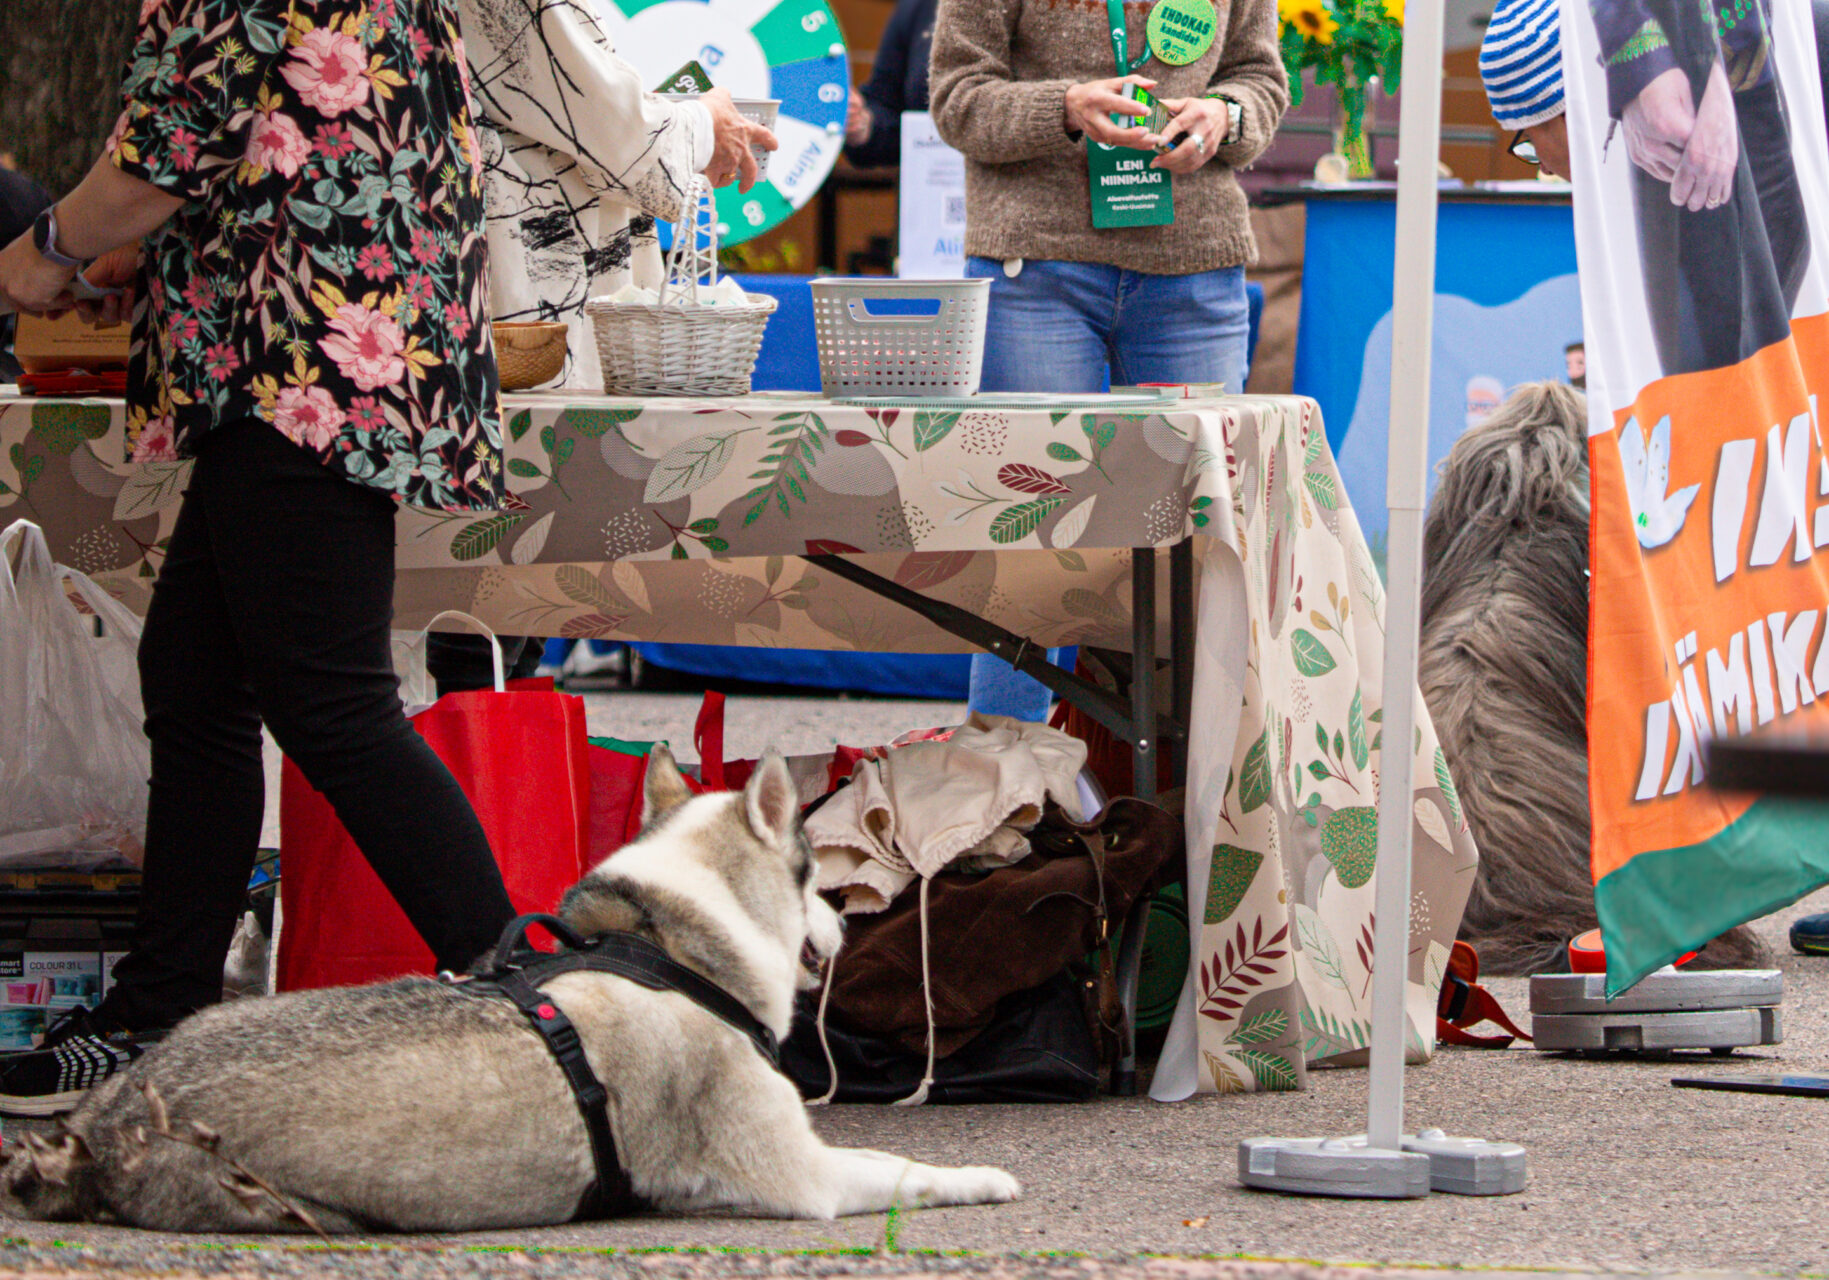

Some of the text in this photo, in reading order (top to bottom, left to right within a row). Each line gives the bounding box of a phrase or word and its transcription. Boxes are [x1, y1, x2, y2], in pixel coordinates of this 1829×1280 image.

[801, 10, 828, 32] 5
[1160, 6, 1211, 36] EHDOKAS
[1160, 22, 1200, 46] kandidat
[817, 83, 845, 103] 6
[784, 140, 822, 187] Alina
[1115, 159, 1145, 171] LENI
[1100, 171, 1162, 187] NIINIMÄKI
[742, 200, 766, 226] 8
[0, 960, 20, 968] mart
[29, 961, 65, 970] COLOUR
[66, 961, 77, 970] 31
